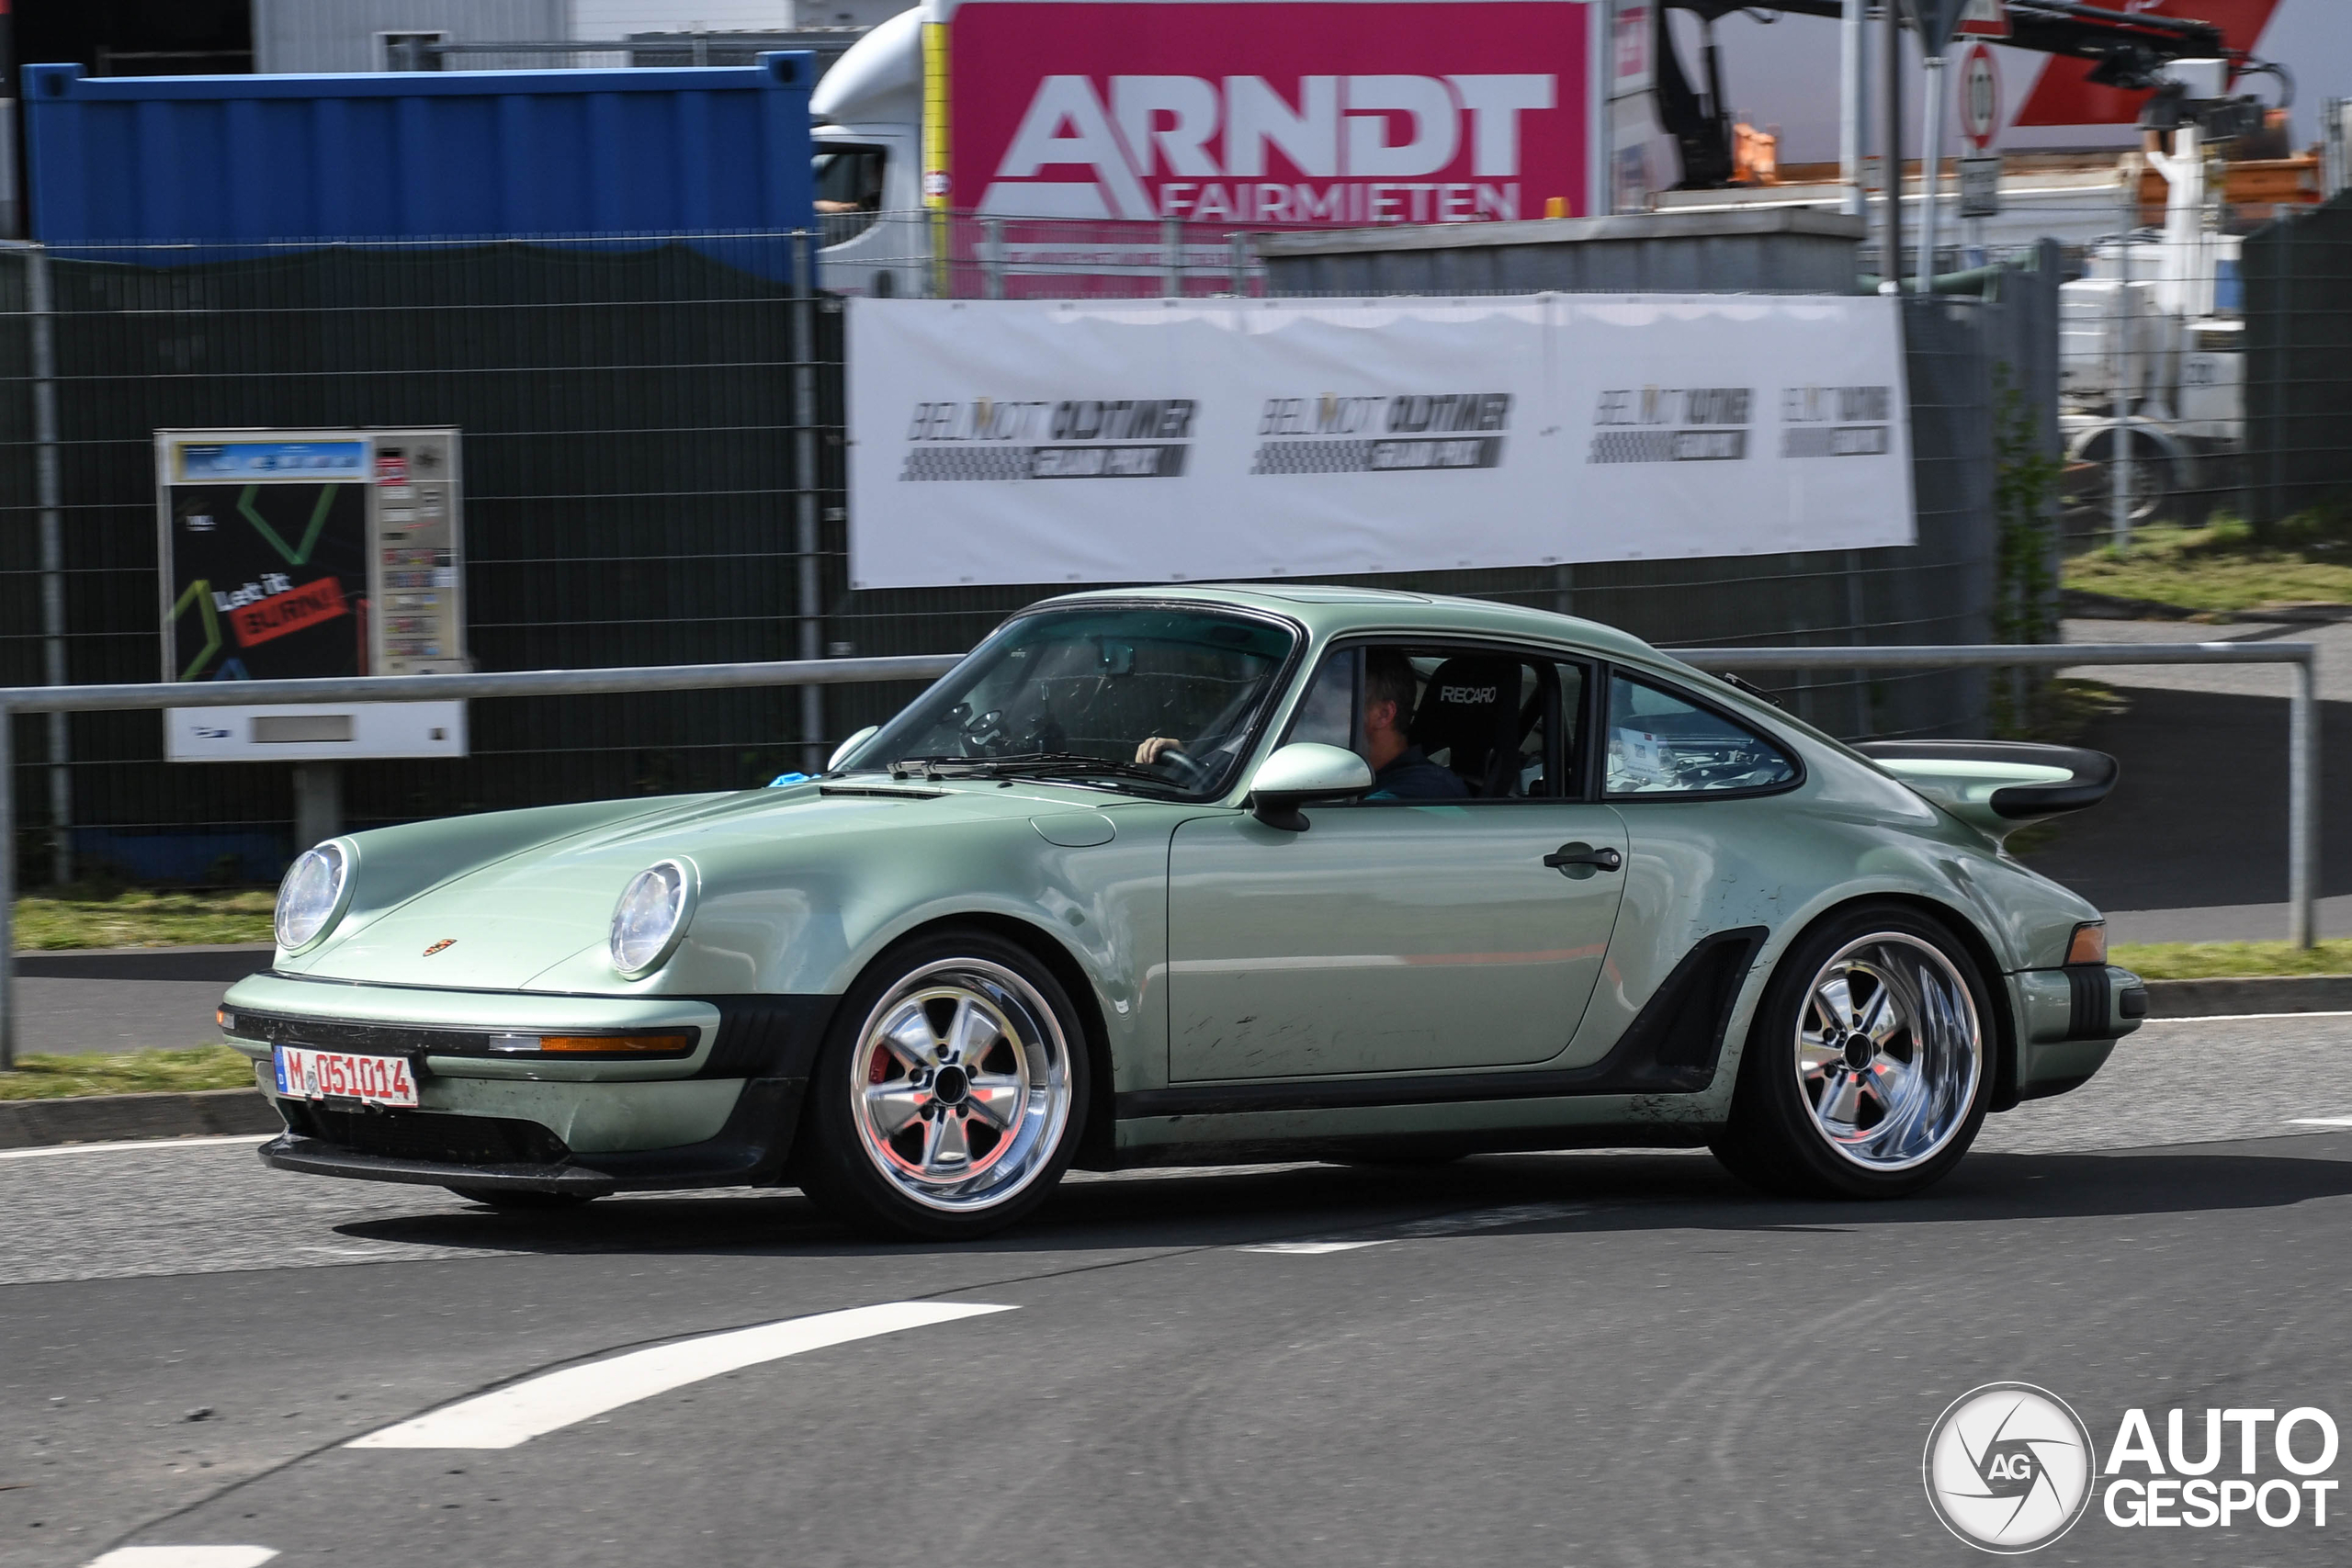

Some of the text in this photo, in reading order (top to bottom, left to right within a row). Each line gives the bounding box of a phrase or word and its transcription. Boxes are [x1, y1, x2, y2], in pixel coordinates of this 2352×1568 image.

[978, 73, 1558, 219] ARNDT
[1160, 183, 1521, 222] FAIRMIETEN
[212, 581, 266, 613] Let
[1440, 685, 1497, 704] RECARO
[287, 1050, 410, 1100] M 051014
